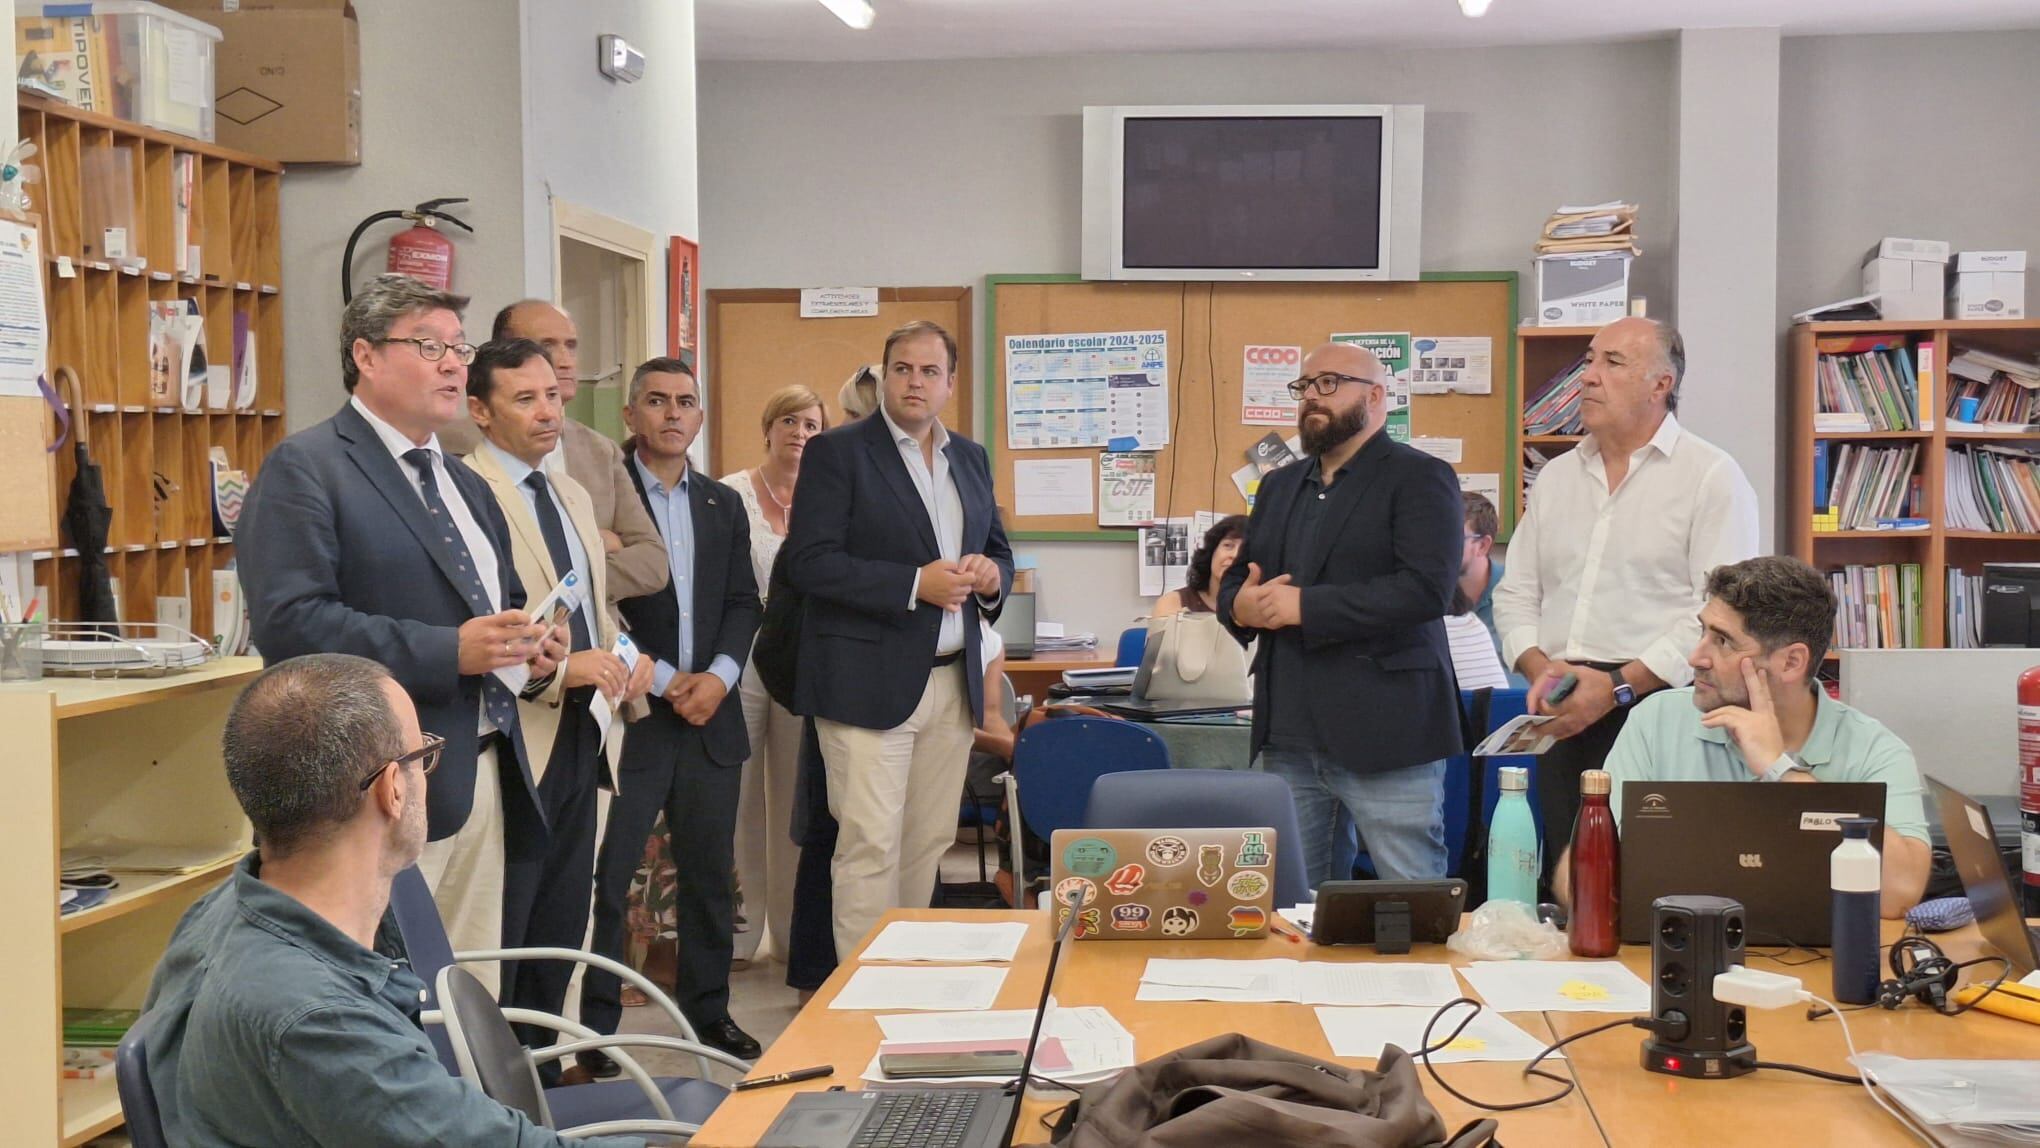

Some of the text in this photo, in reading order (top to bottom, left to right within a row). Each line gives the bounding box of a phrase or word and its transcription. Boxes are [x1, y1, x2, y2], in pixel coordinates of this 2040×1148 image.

[1009, 334, 1165, 350] Calendario escolar 2024-2025
[1246, 347, 1299, 366] CCOO
[1369, 343, 1401, 359] ACIÓN
[1141, 361, 1164, 369] ANPE
[1111, 480, 1152, 497] CSIF
[1802, 817, 1832, 826] PABLO
